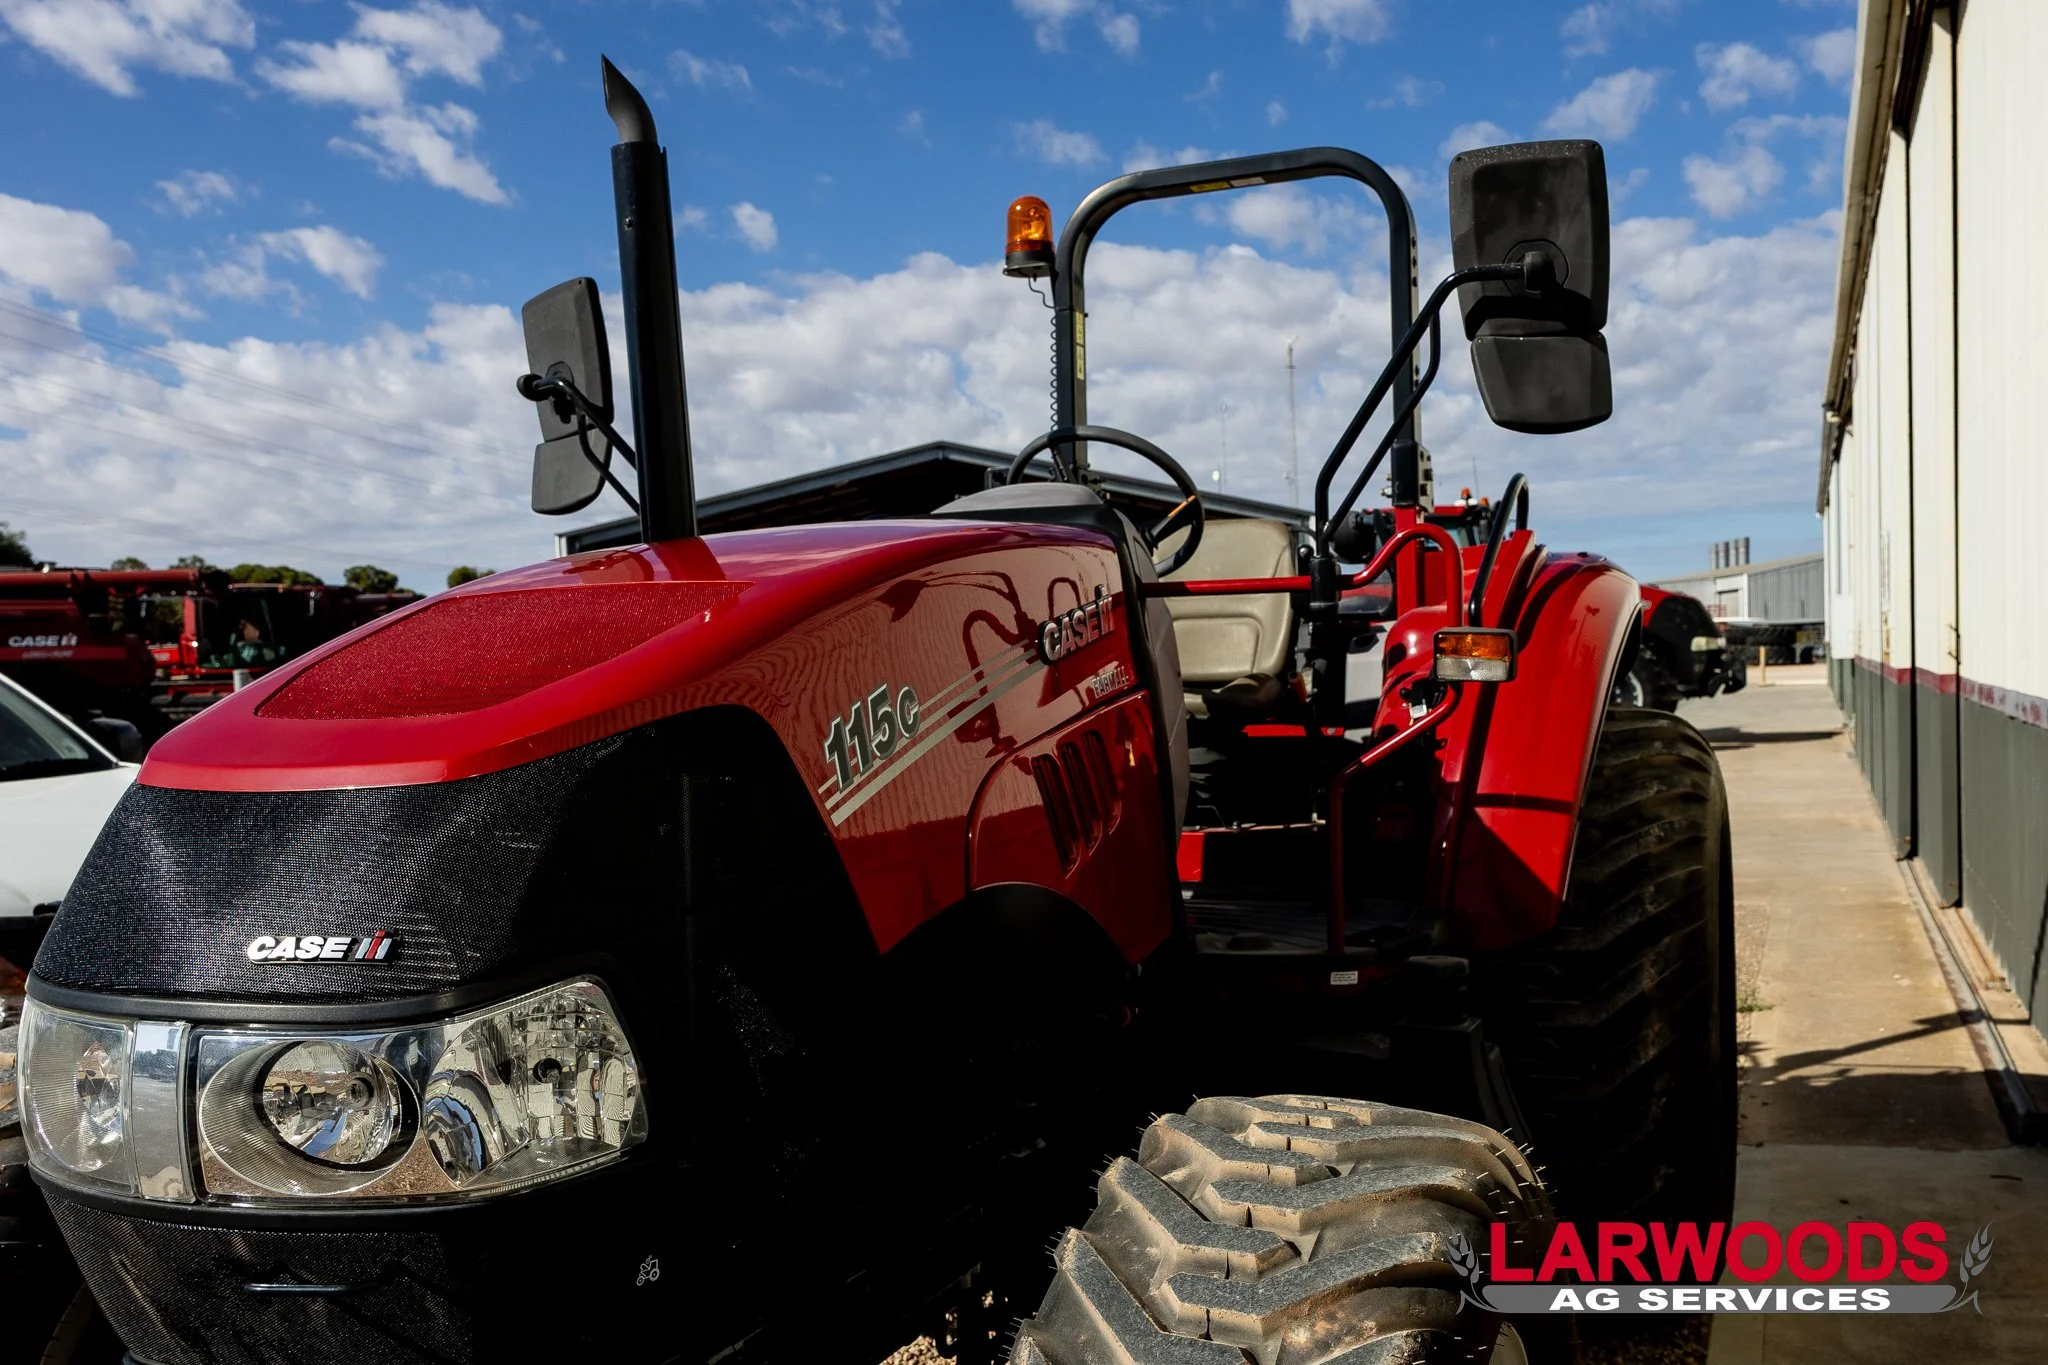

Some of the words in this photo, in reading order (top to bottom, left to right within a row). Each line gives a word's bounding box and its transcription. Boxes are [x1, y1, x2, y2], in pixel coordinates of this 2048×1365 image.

[8, 635, 60, 648] CASE
[1041, 605, 1099, 661] CASE
[1091, 666, 1129, 699] FARMALL
[247, 935, 351, 960] CASE
